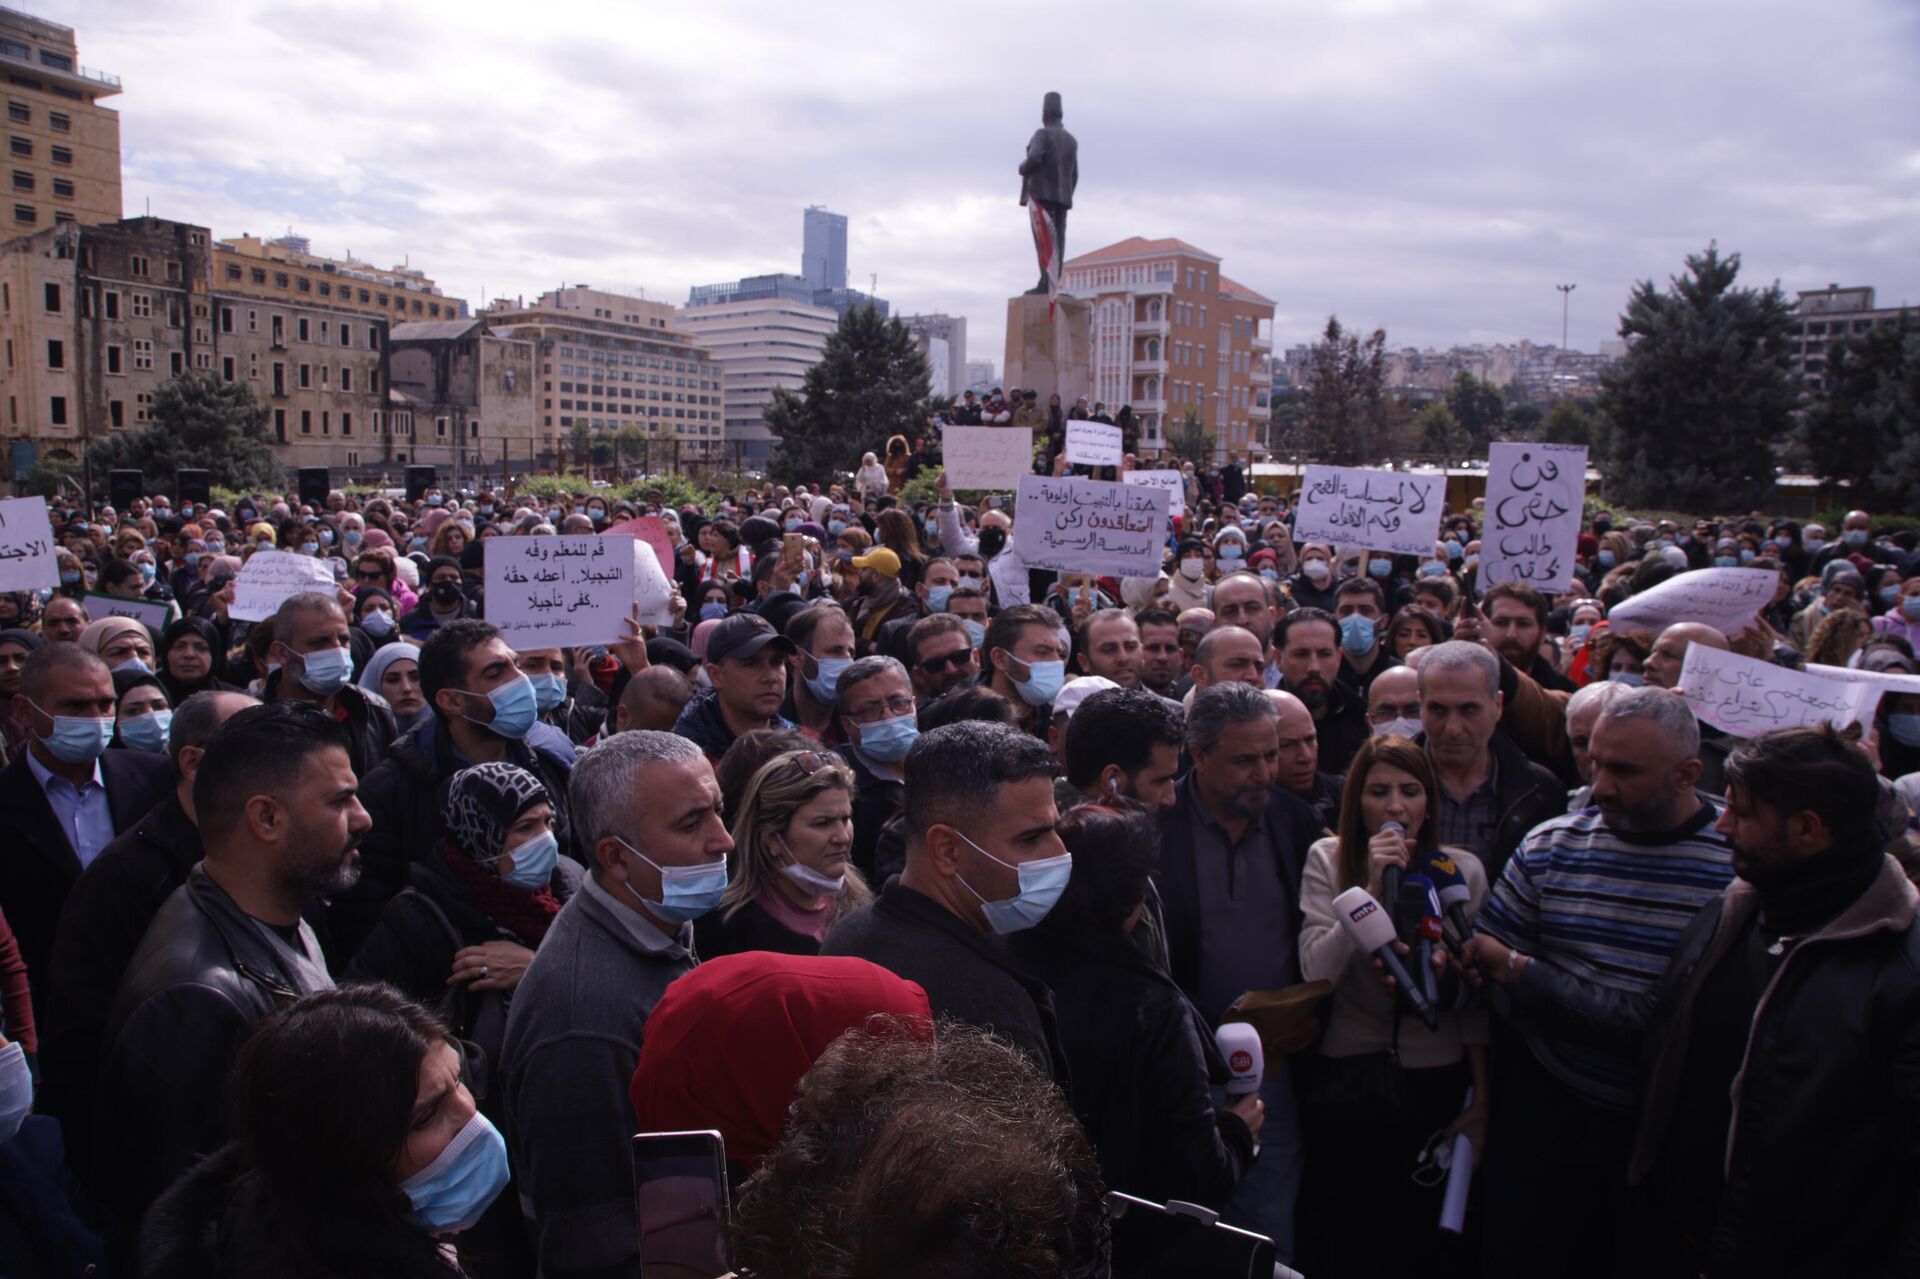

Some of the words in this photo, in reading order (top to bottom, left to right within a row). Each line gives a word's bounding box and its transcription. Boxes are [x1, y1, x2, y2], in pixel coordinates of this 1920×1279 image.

[1409, 481, 1432, 514] لا
[1055, 506, 1083, 531] ركن
[1087, 512, 1154, 533] المتعاقدون
[1495, 492, 1569, 531] حقي
[1097, 536, 1153, 559] المدرسة
[1499, 533, 1552, 560] طالب
[1353, 902, 1377, 921] mtv
